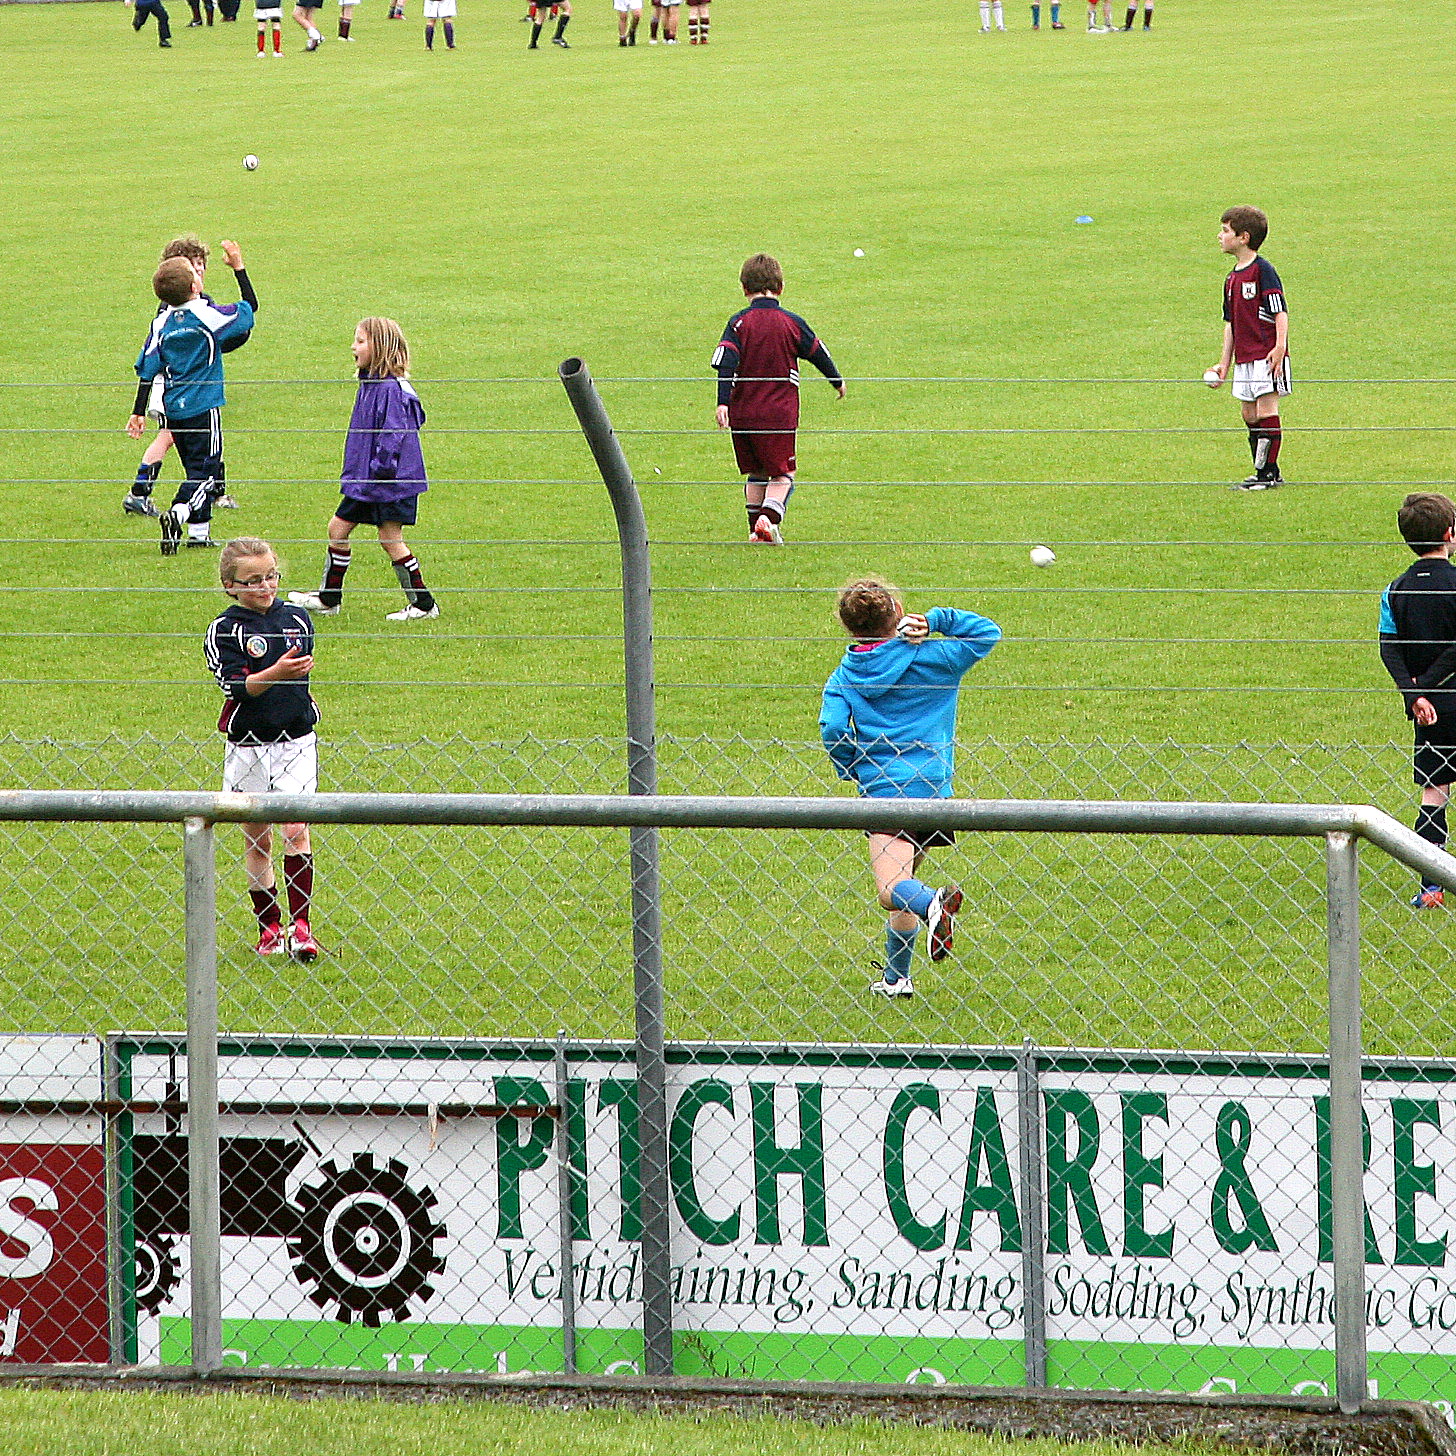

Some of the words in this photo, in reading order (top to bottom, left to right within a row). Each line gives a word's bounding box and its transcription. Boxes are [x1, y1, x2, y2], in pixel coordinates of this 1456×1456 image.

[492, 1075, 831, 1248] PITCH
[883, 1082, 1177, 1259] CARE
[1210, 1099, 1280, 1256] &
[832, 1256, 1026, 1330] Sanding,
[1047, 1264, 1206, 1340] Sodding,
